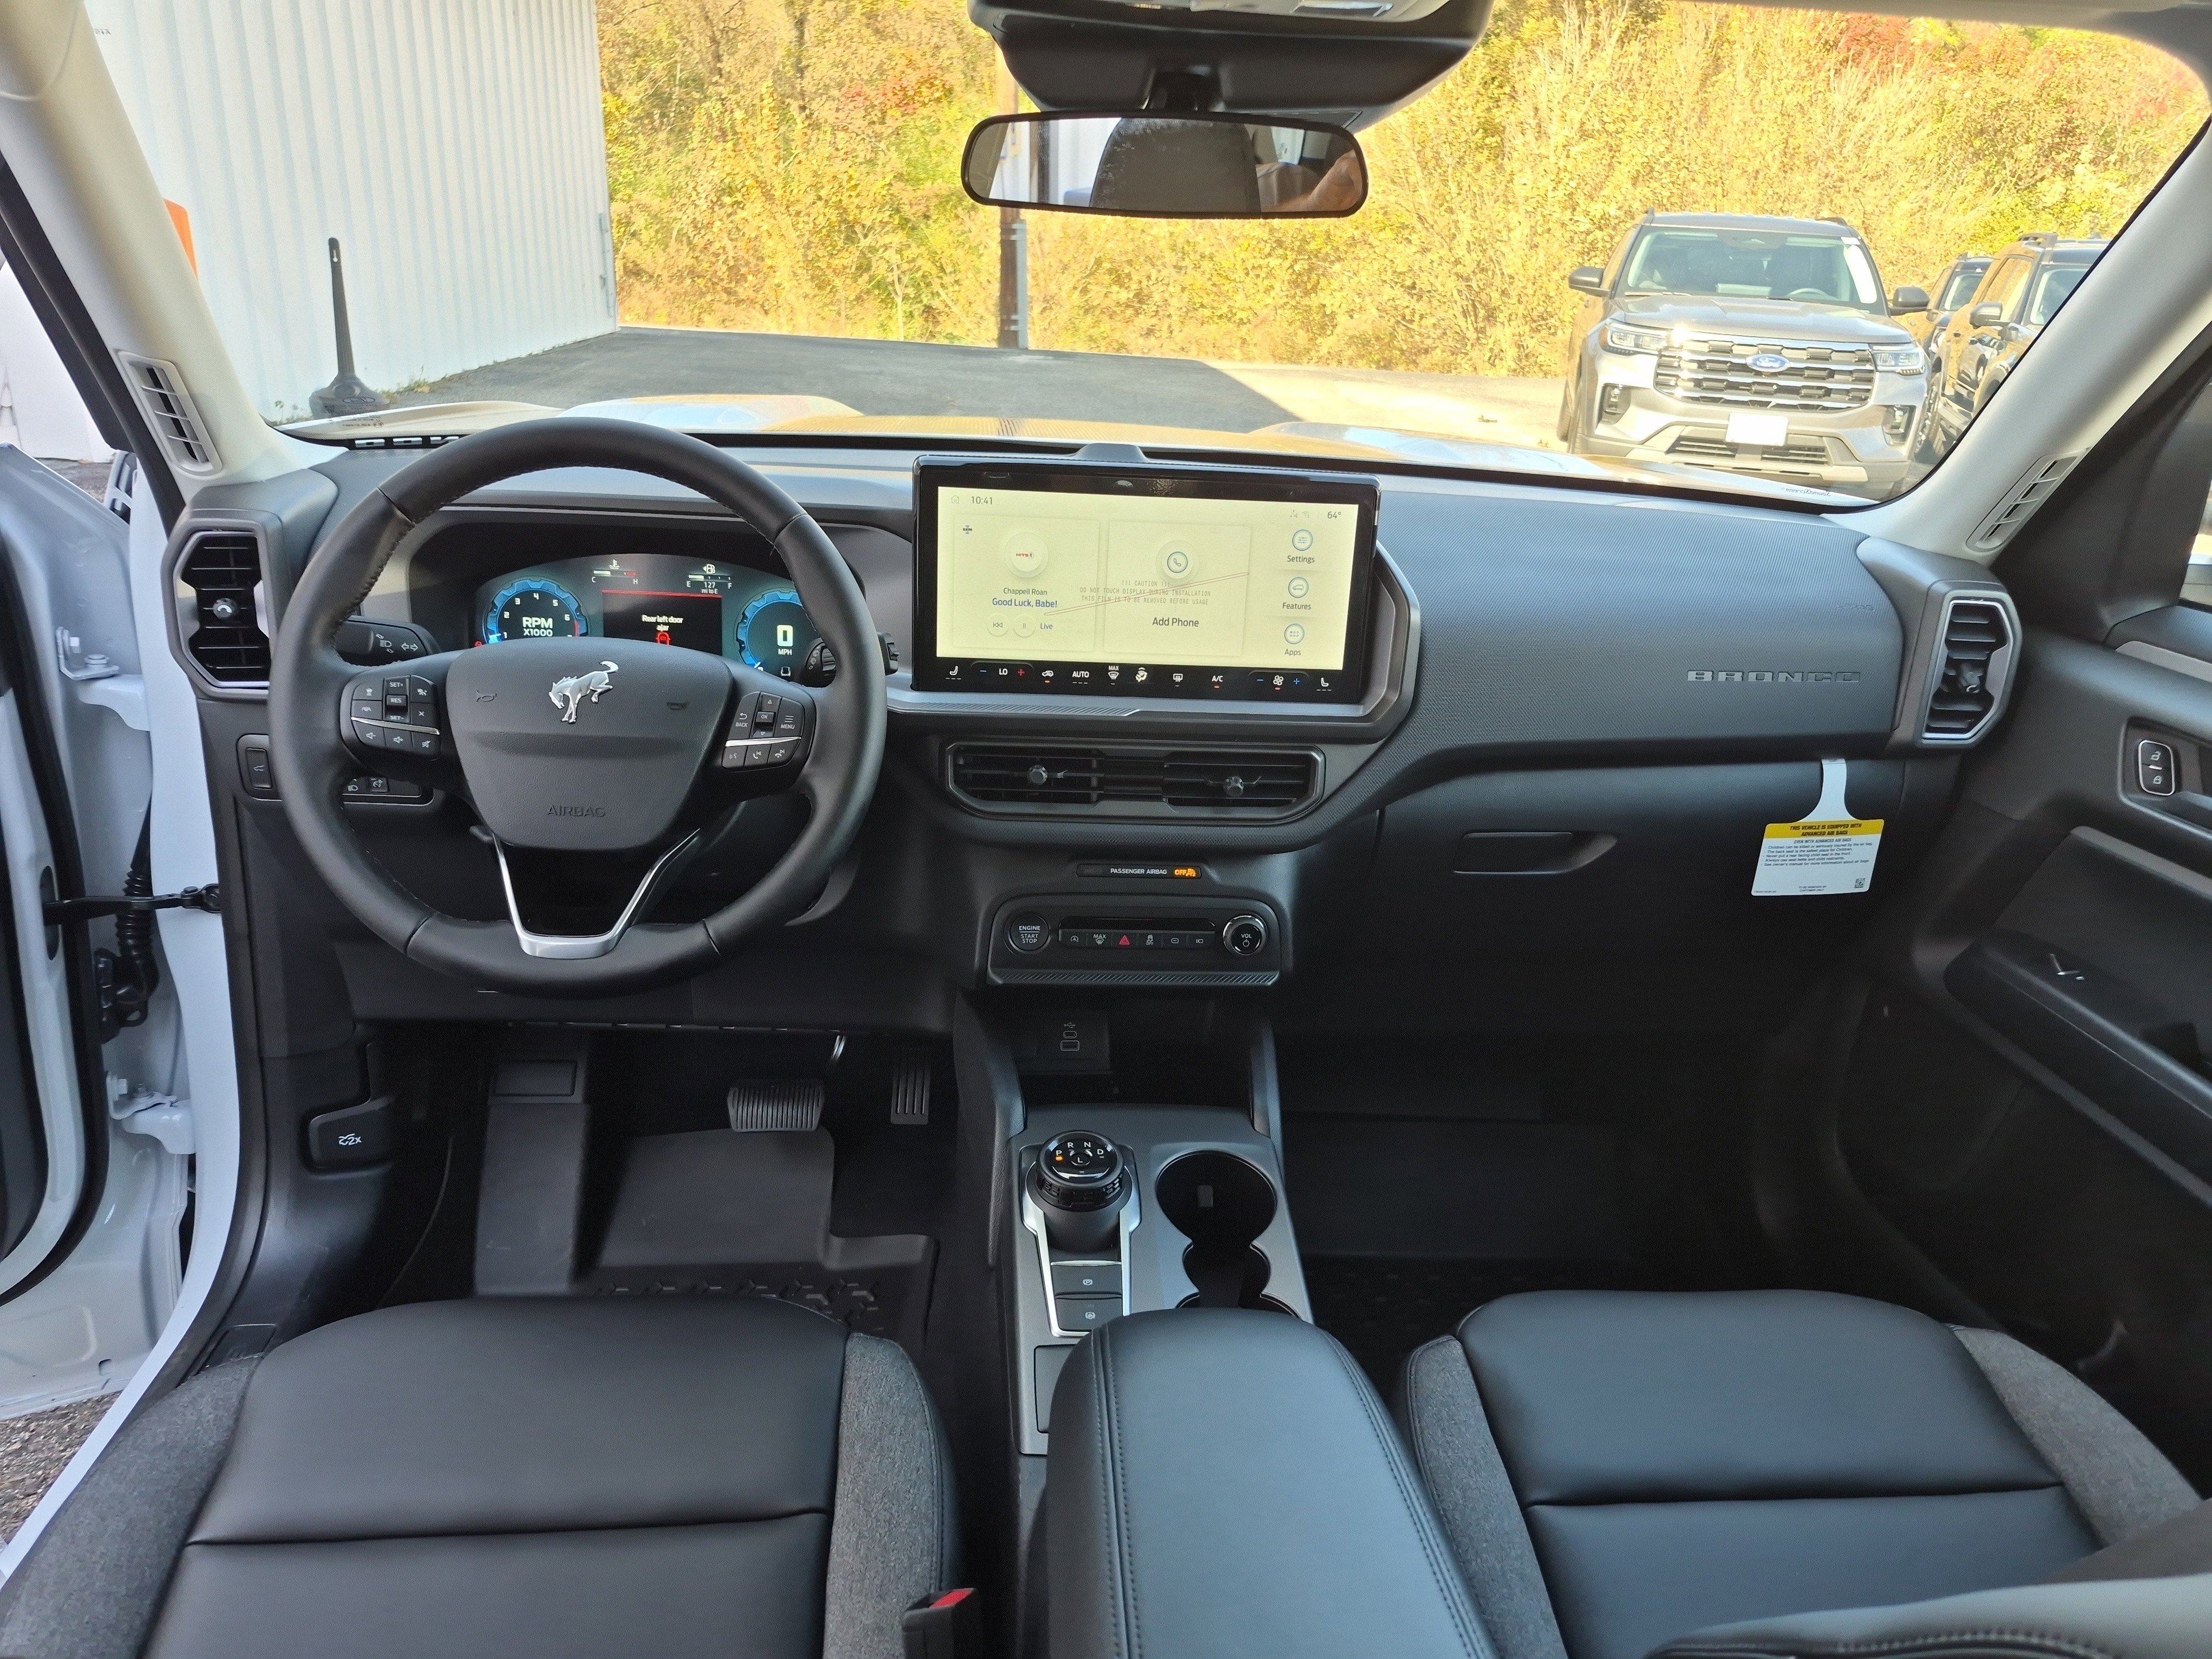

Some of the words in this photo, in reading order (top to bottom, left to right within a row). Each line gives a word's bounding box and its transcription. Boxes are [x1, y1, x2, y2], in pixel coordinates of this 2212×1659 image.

[971, 496, 993, 505] 10:41
[1287, 555, 1315, 564] Settings
[1014, 599, 1033, 608] Luck,
[1036, 600, 1057, 608] Babe!
[522, 616, 553, 629] RPM
[642, 614, 657, 623] Rear
[1152, 617, 1169, 626] Add
[1172, 618, 1199, 627] Phone
[523, 628, 553, 637] X1000
[777, 625, 793, 647] 0
[1284, 648, 1301, 657] Apps
[1687, 670, 1860, 683] BRONCO
[547, 805, 606, 818] AIRBAG
[348, 1136, 362, 1146] 2x
